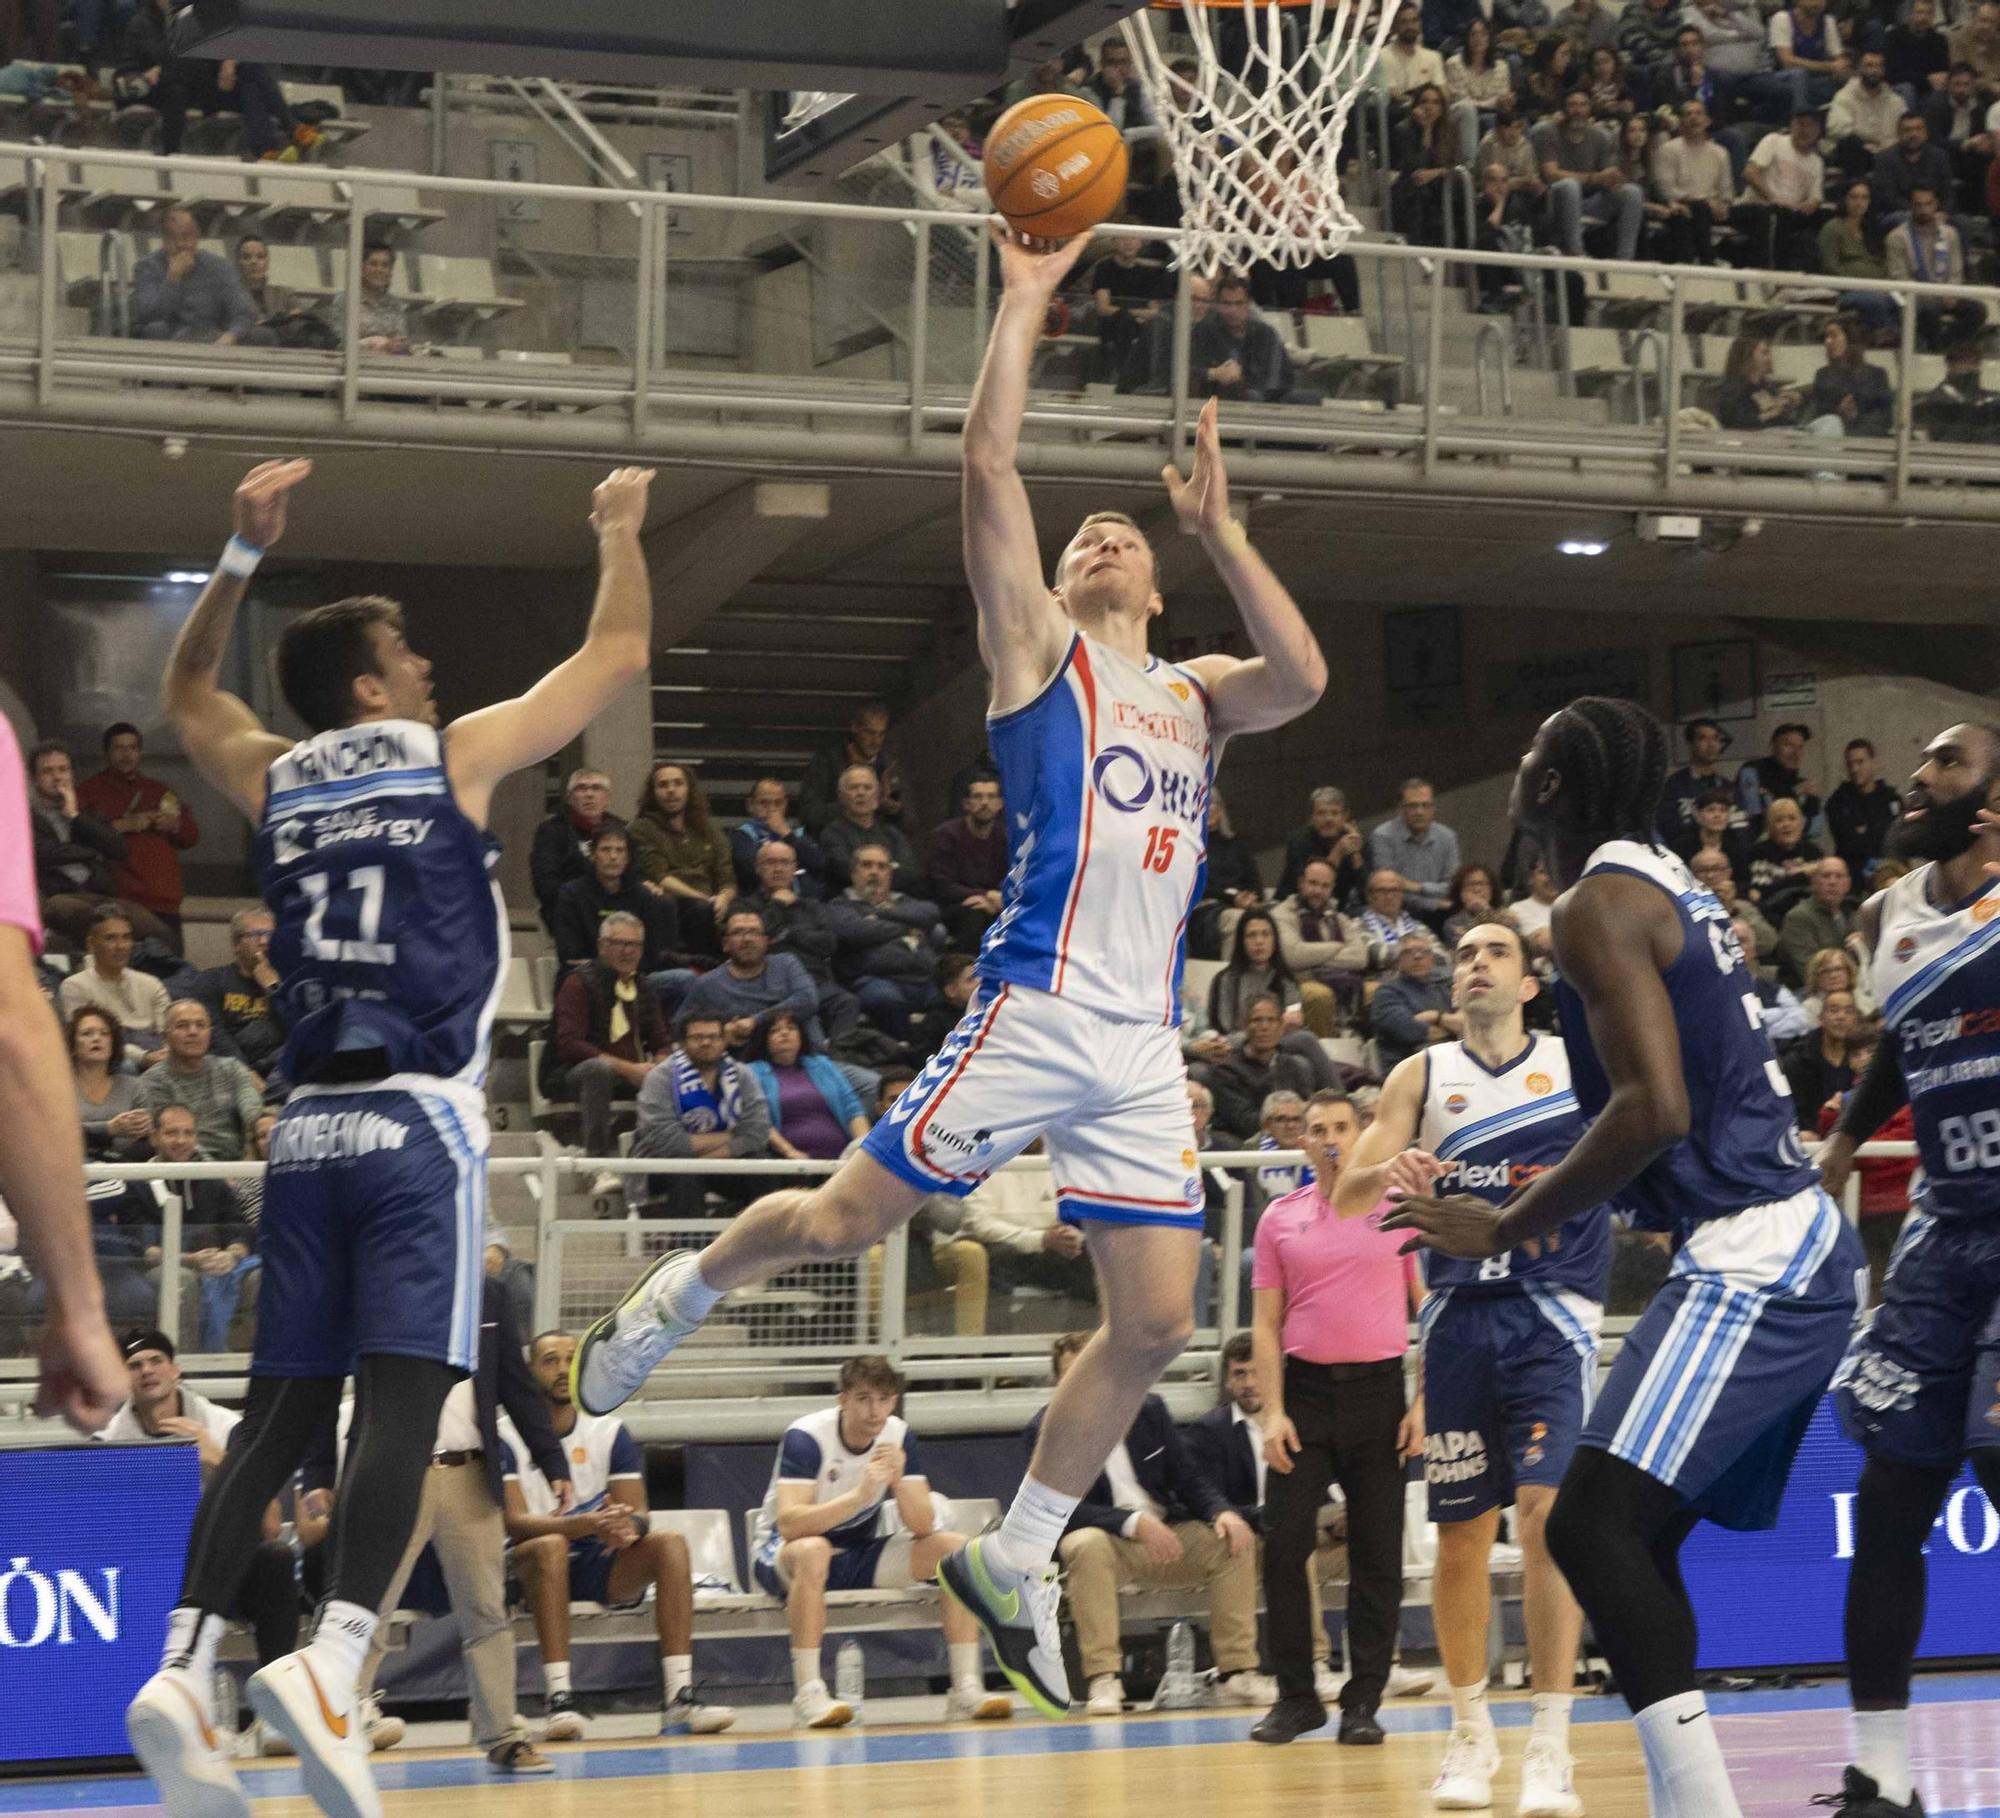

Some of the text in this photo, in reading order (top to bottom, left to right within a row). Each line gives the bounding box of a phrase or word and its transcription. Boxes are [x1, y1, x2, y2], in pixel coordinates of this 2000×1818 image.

[315, 818, 435, 849] energy
[1142, 825, 1180, 874] 15
[495, 1106, 509, 1131] 3
[1938, 1108, 2000, 1173] 88
